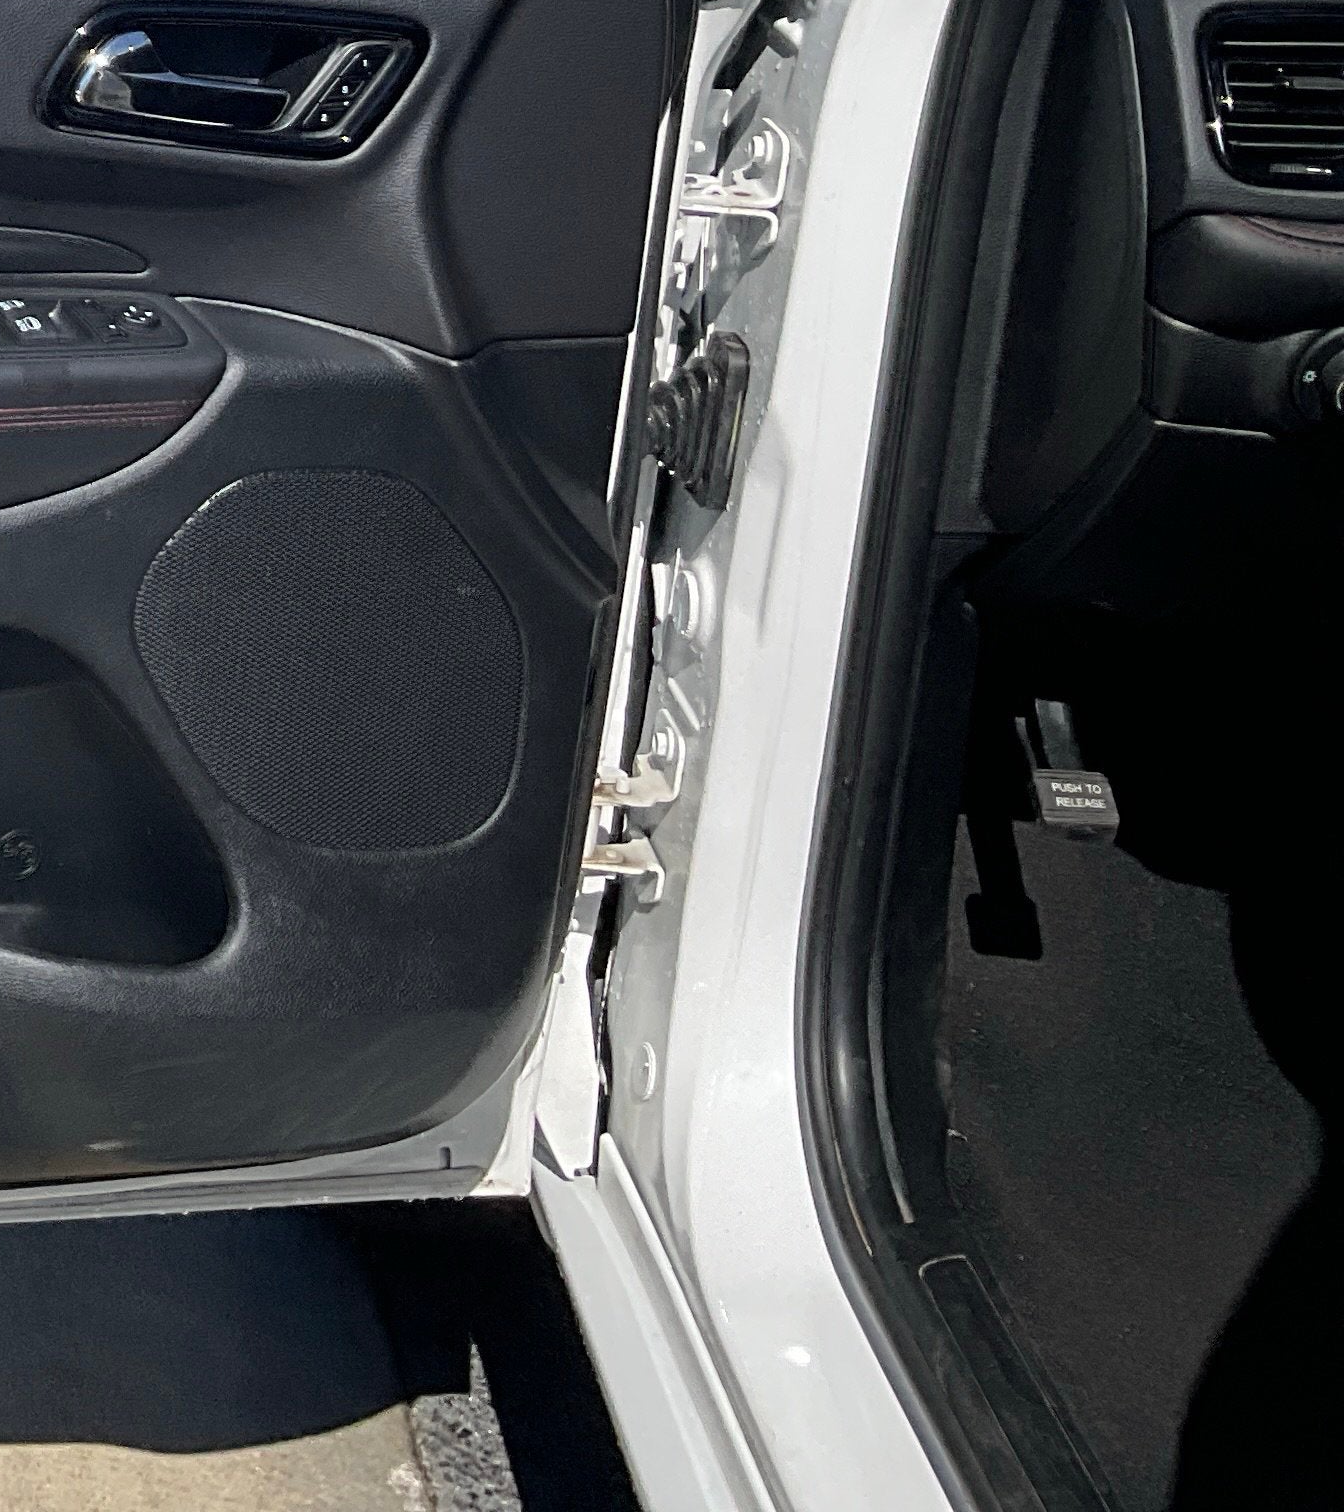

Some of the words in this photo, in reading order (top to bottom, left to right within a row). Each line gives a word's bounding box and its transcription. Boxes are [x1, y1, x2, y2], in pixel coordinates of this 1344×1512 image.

[320, 113, 328, 122] 2
[1050, 781, 1083, 794] PUSH
[1086, 783, 1102, 795] TO
[1055, 796, 1107, 809] RELEASE
